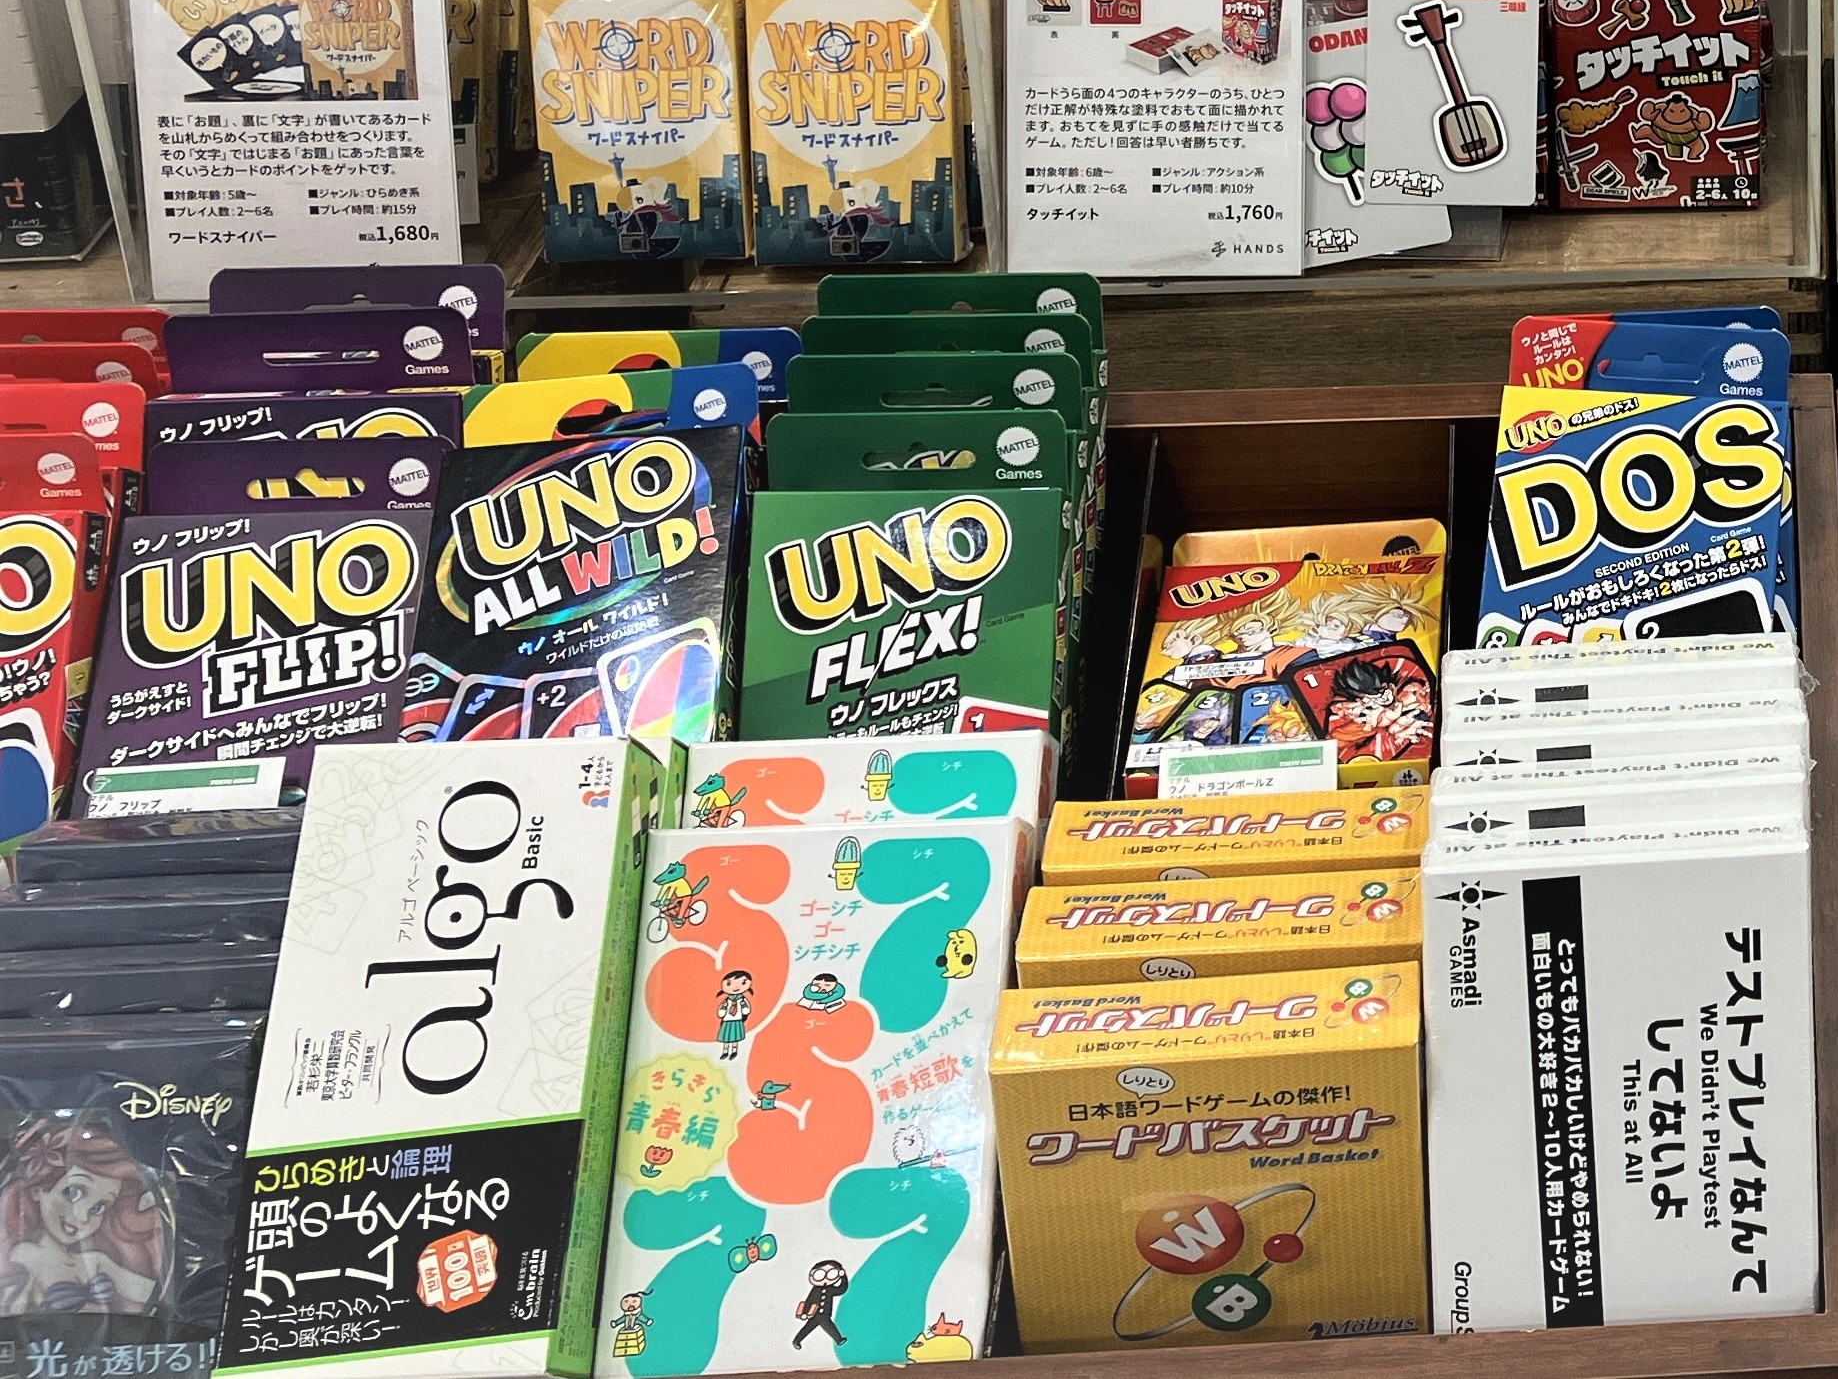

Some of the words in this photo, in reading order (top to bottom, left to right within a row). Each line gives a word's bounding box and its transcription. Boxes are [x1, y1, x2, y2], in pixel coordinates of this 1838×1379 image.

[545, 18, 714, 73] WORD
[764, 18, 931, 73] WORD
[1577, 34, 1751, 88] タッチイット
[540, 68, 731, 126] SNIPER
[756, 69, 945, 126] SNIPER
[1025, 87, 1285, 101] カードうら面の4つのキャラクターのうち、ひとつ
[1661, 72, 1709, 87] Touch
[1712, 70, 1724, 84] it
[157, 114, 431, 129] 表に「お題」、裏に「文字」が書いてあるカード
[1025, 104, 1284, 117] だけ正解が特殊な塗料でおもて面に描かれて
[1025, 120, 1284, 133] ます。おもてを見ずに手の感触だけで当てる
[158, 131, 413, 145] を山札からめくって組み合わせをつくります。
[159, 147, 425, 161] その「文字」ではじまる「お題」にあった言葉を
[588, 131, 686, 147] ワードスナイパー
[802, 132, 899, 148] ワードスナイパー
[161, 163, 397, 178] 早くいうとカードのポイントをゲットです。
[1027, 208, 1099, 221] タッチイット
[1208, 204, 1283, 223] 税込1,760円
[168, 229, 277, 245] ワードスナイパー
[359, 225, 439, 243] 税込1,680円
[1234, 244, 1284, 254] HANDS
[405, 363, 450, 376] Games
[1720, 384, 1763, 397] Games
[1508, 412, 1568, 449] UNO
[1571, 398, 1639, 425] の兄弟のドス!
[996, 467, 1042, 480] Games
[452, 436, 695, 580] UNO
[1491, 405, 1789, 589] DOS
[472, 566, 563, 635] ALL
[561, 507, 721, 597] WILD!
[764, 496, 1011, 634] UNO
[1595, 557, 1643, 579] SECOND
[1644, 543, 1689, 565] EDITION
[123, 521, 419, 670] UNO
[1173, 568, 1280, 608] UNO
[203, 615, 407, 717] FLIP!
[808, 597, 983, 704] FLEX!
[110, 681, 189, 707] うらがえすと
[522, 816, 545, 870] Basic
[800, 900, 863, 918] ゴーシチ
[364, 779, 574, 1096] algo
[794, 941, 861, 961] シチシチ
[1449, 947, 1464, 1008] GAMES
[1462, 918, 1483, 1007] Asmadi
[1700, 1003, 1718, 1042] We
[1122, 1071, 1171, 1090] しりとり
[1622, 1059, 1640, 1113] This
[1068, 1086, 1352, 1122] 日本語ワードゲームの傑作!
[1646, 1016, 1689, 1222] してないよ
[1725, 926, 1769, 1295] テストプレイなんて
[625, 1099, 718, 1150] 青春編
[1027, 1109, 1395, 1166] ワードバスケット
[1624, 1119, 1642, 1146] at
[255, 1144, 452, 1193] ひらめきと論理
[1249, 1152, 1305, 1169] Word
[1306, 1148, 1380, 1167] Basket
[1625, 1153, 1643, 1185] All
[1702, 1120, 1721, 1230] Playtest
[26, 1338, 216, 1378] 光が透ける!!
